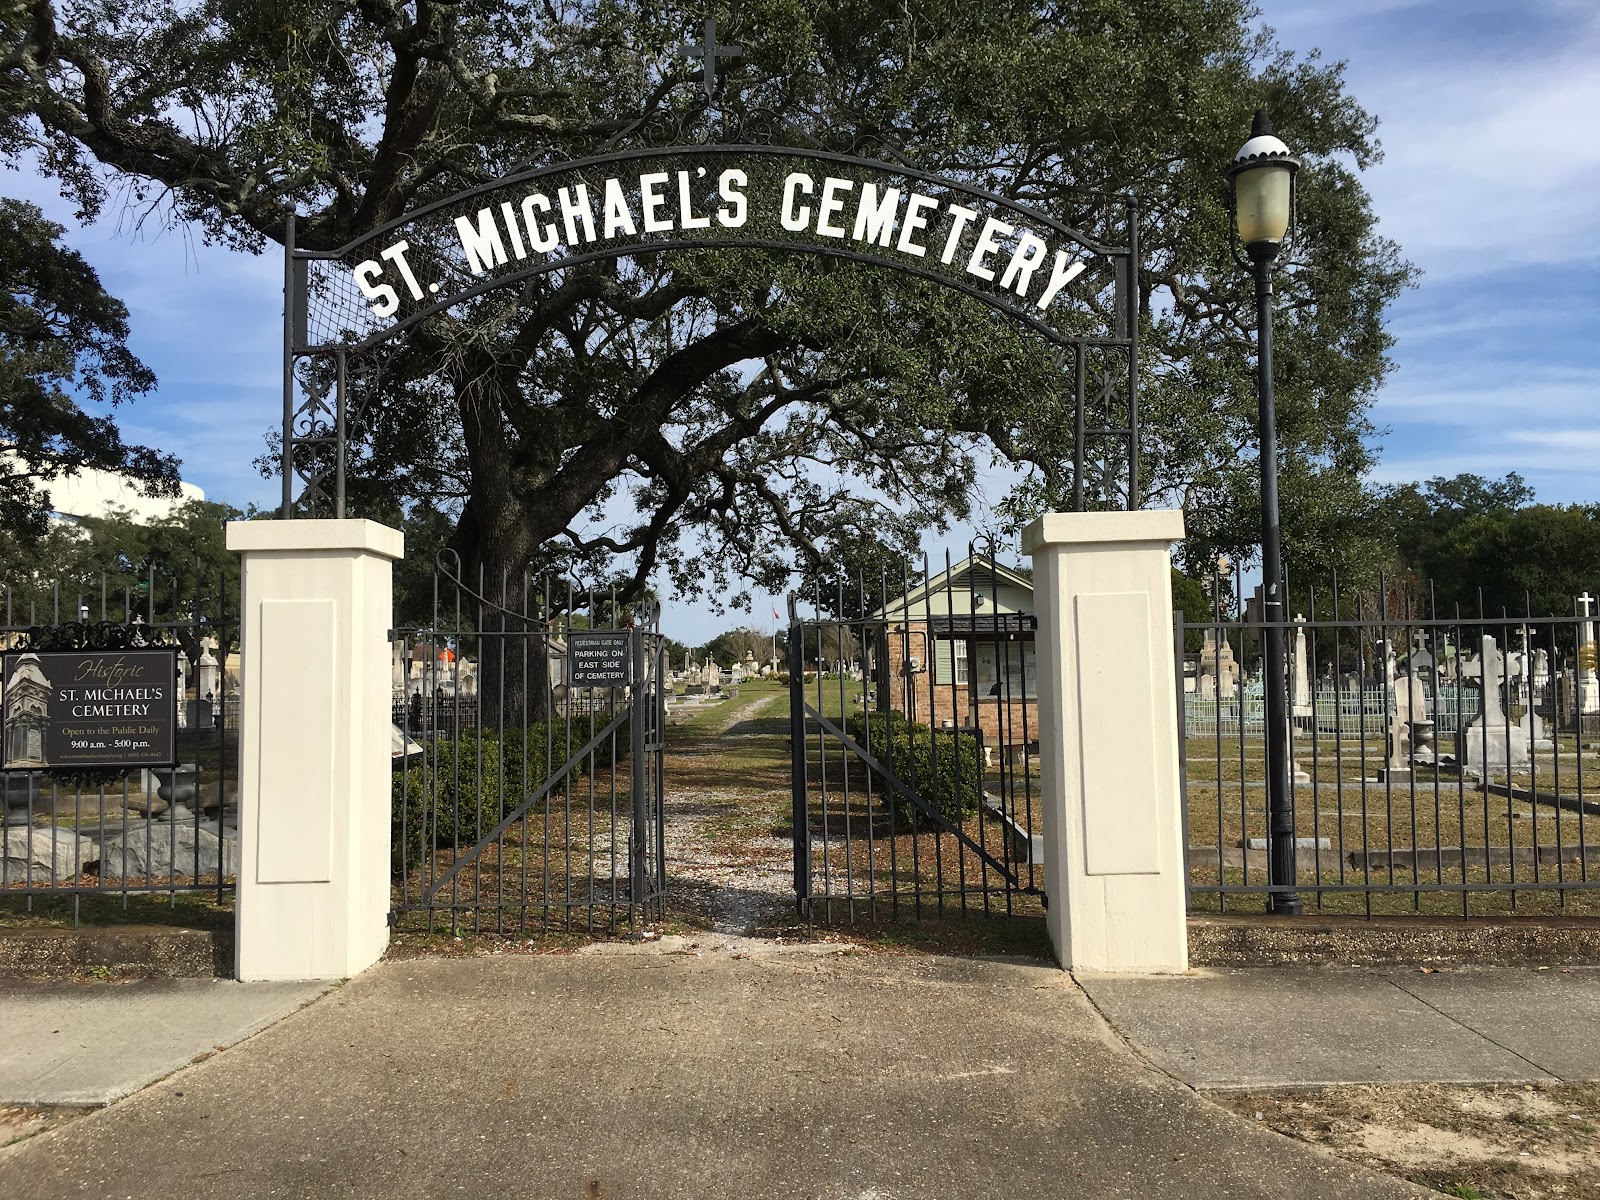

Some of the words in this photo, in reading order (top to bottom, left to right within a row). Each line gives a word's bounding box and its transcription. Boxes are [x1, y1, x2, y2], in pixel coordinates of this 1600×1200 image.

[353, 240, 439, 318] ST.
[454, 167, 748, 276] MICHAEL'S
[780, 172, 1087, 310] CEMETERY
[578, 661, 599, 669] EAST
[74, 656, 144, 689] Historic
[574, 672, 584, 680] OF
[587, 671, 625, 679] CEMETERY
[59, 689, 79, 702] ST.
[84, 687, 163, 701] MICHAEL'S
[72, 704, 150, 717] CEMETERY
[62, 727, 85, 737] Open
[97, 726, 110, 735] the
[112, 726, 136, 735] Public
[138, 725, 160, 736] Daily
[71, 740, 88, 749] 9:00
[113, 739, 131, 748] 5:00
[132, 740, 150, 750] p.m.
